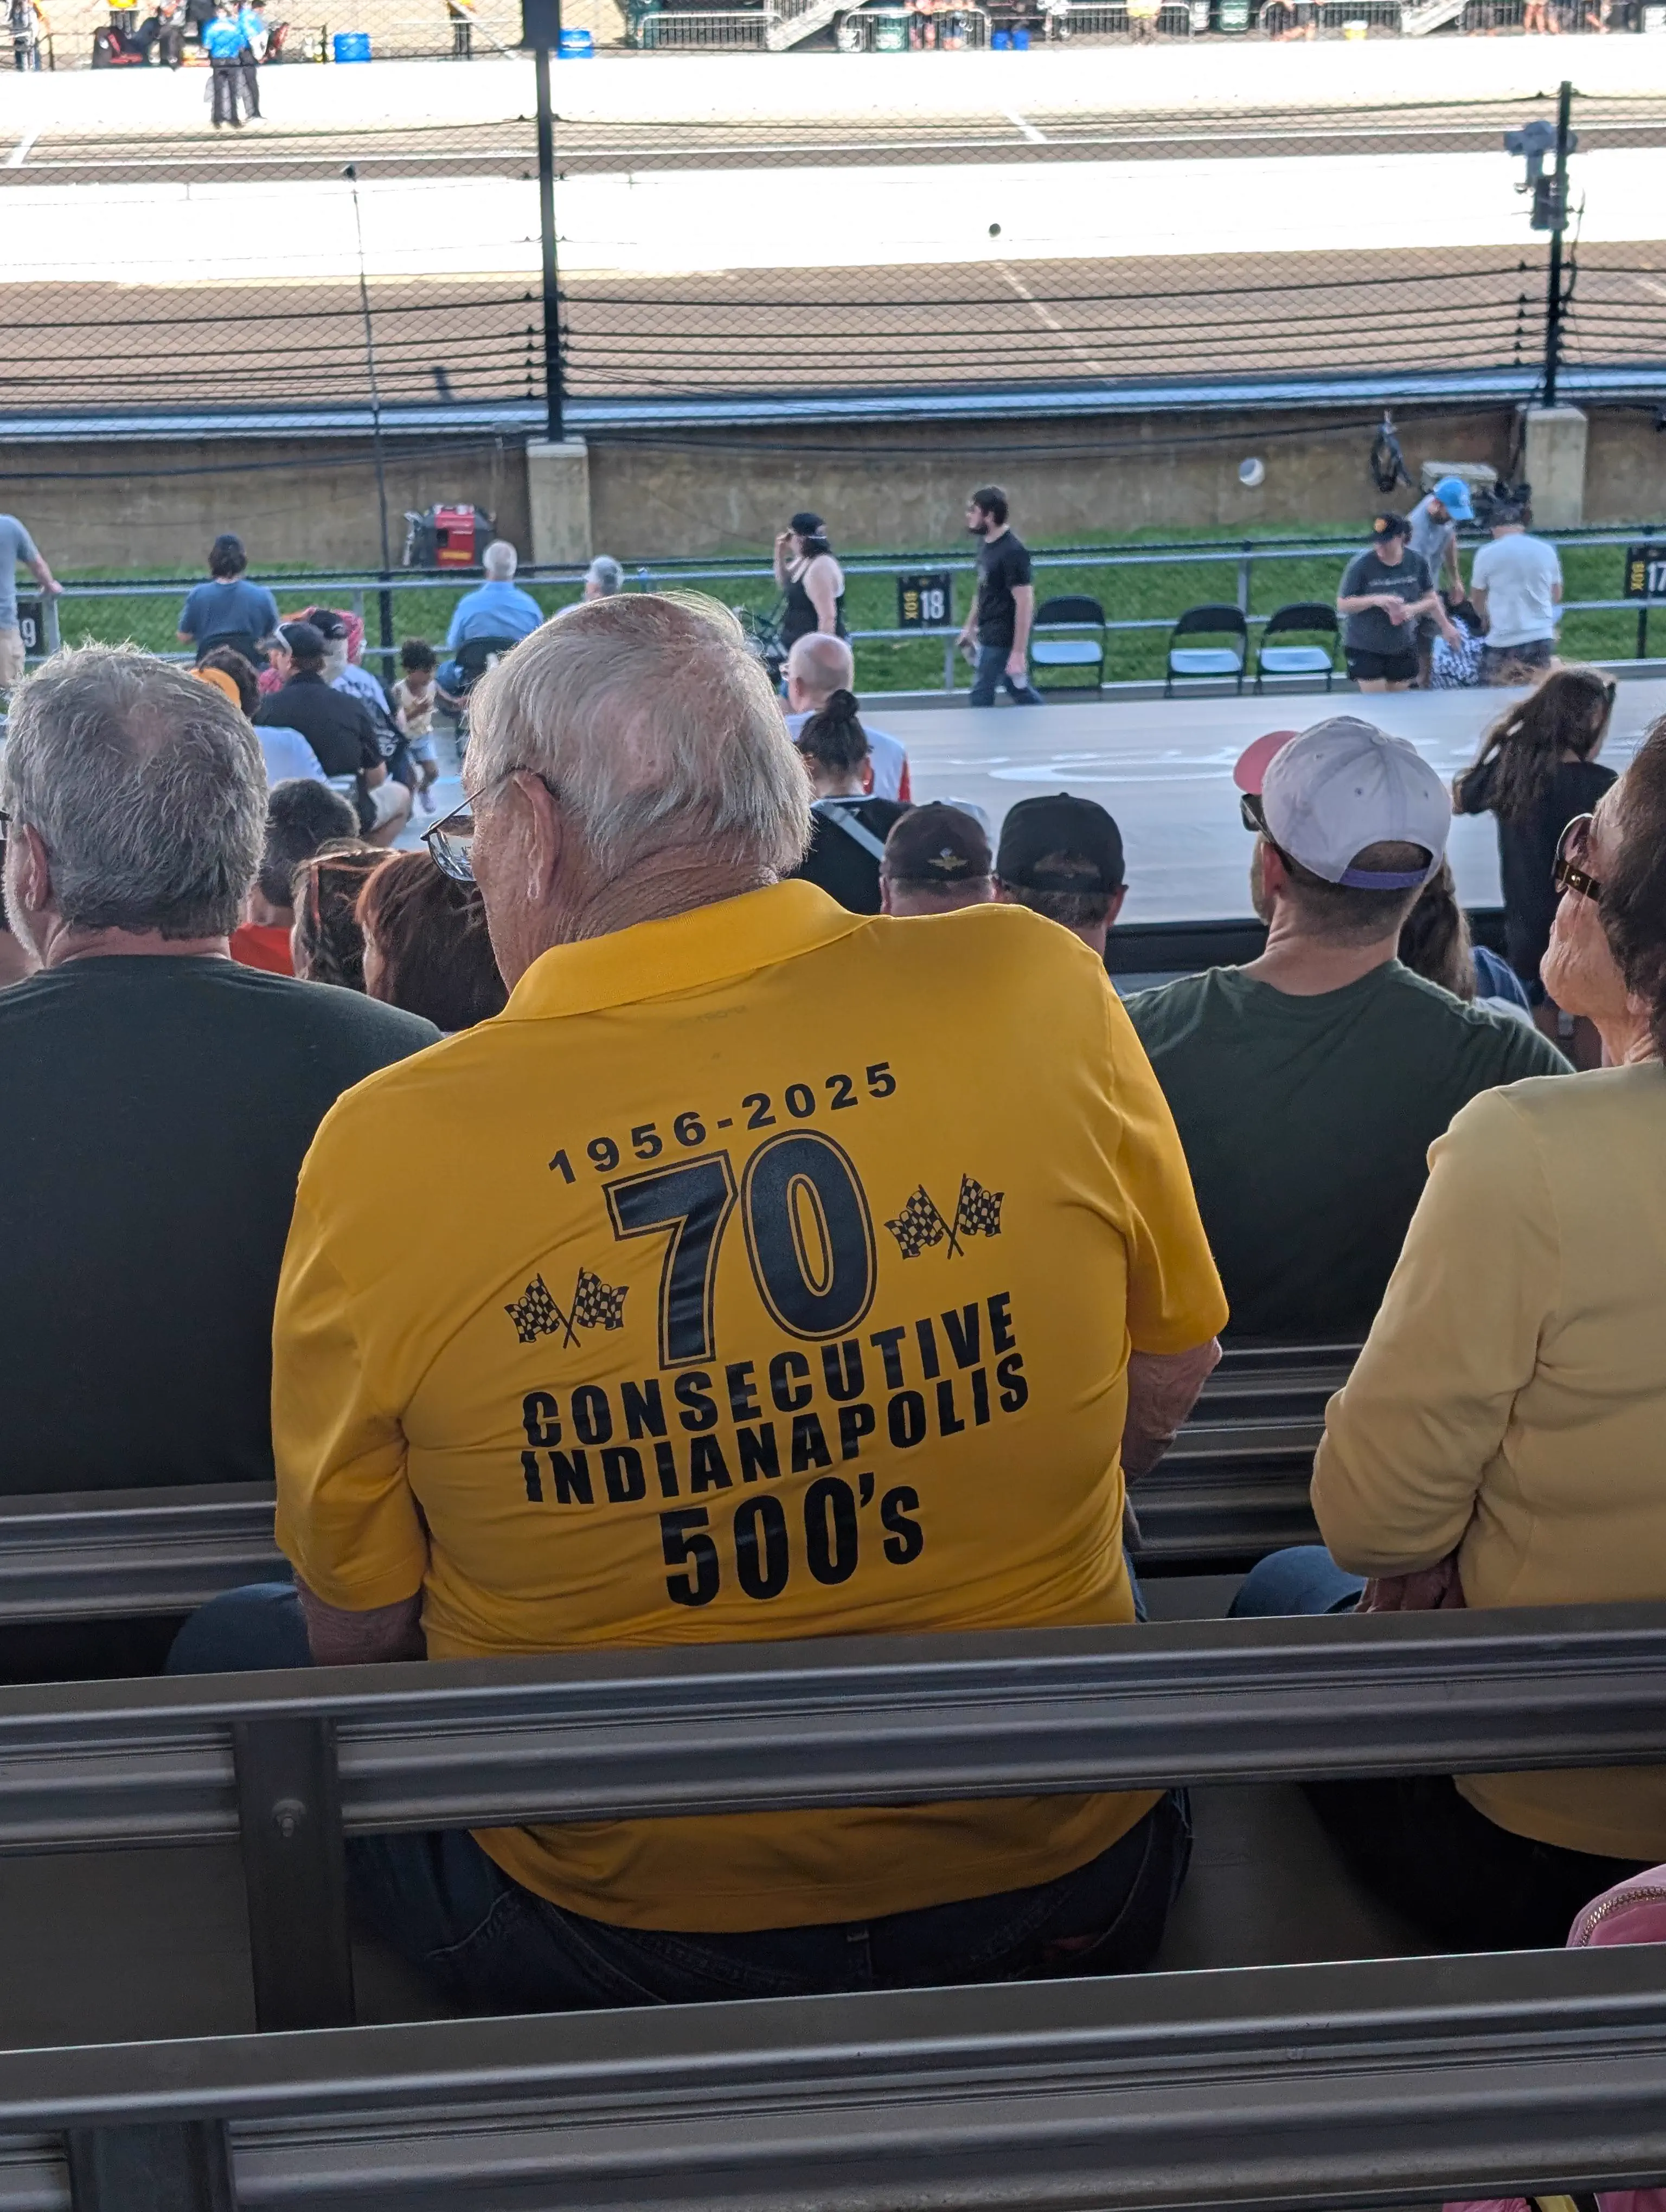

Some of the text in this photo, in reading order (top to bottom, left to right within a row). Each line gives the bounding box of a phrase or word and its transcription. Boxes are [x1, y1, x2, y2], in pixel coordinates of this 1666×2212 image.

[22, 619, 36, 647] 9
[920, 589, 944, 619] 18
[1648, 561, 1666, 591] 17
[548, 1062, 896, 1184] 1956-2025
[601, 1128, 878, 1371] 70
[520, 1352, 1029, 1505] INDIANAPOLIS
[522, 1291, 1017, 1449] CONSECUTIVE
